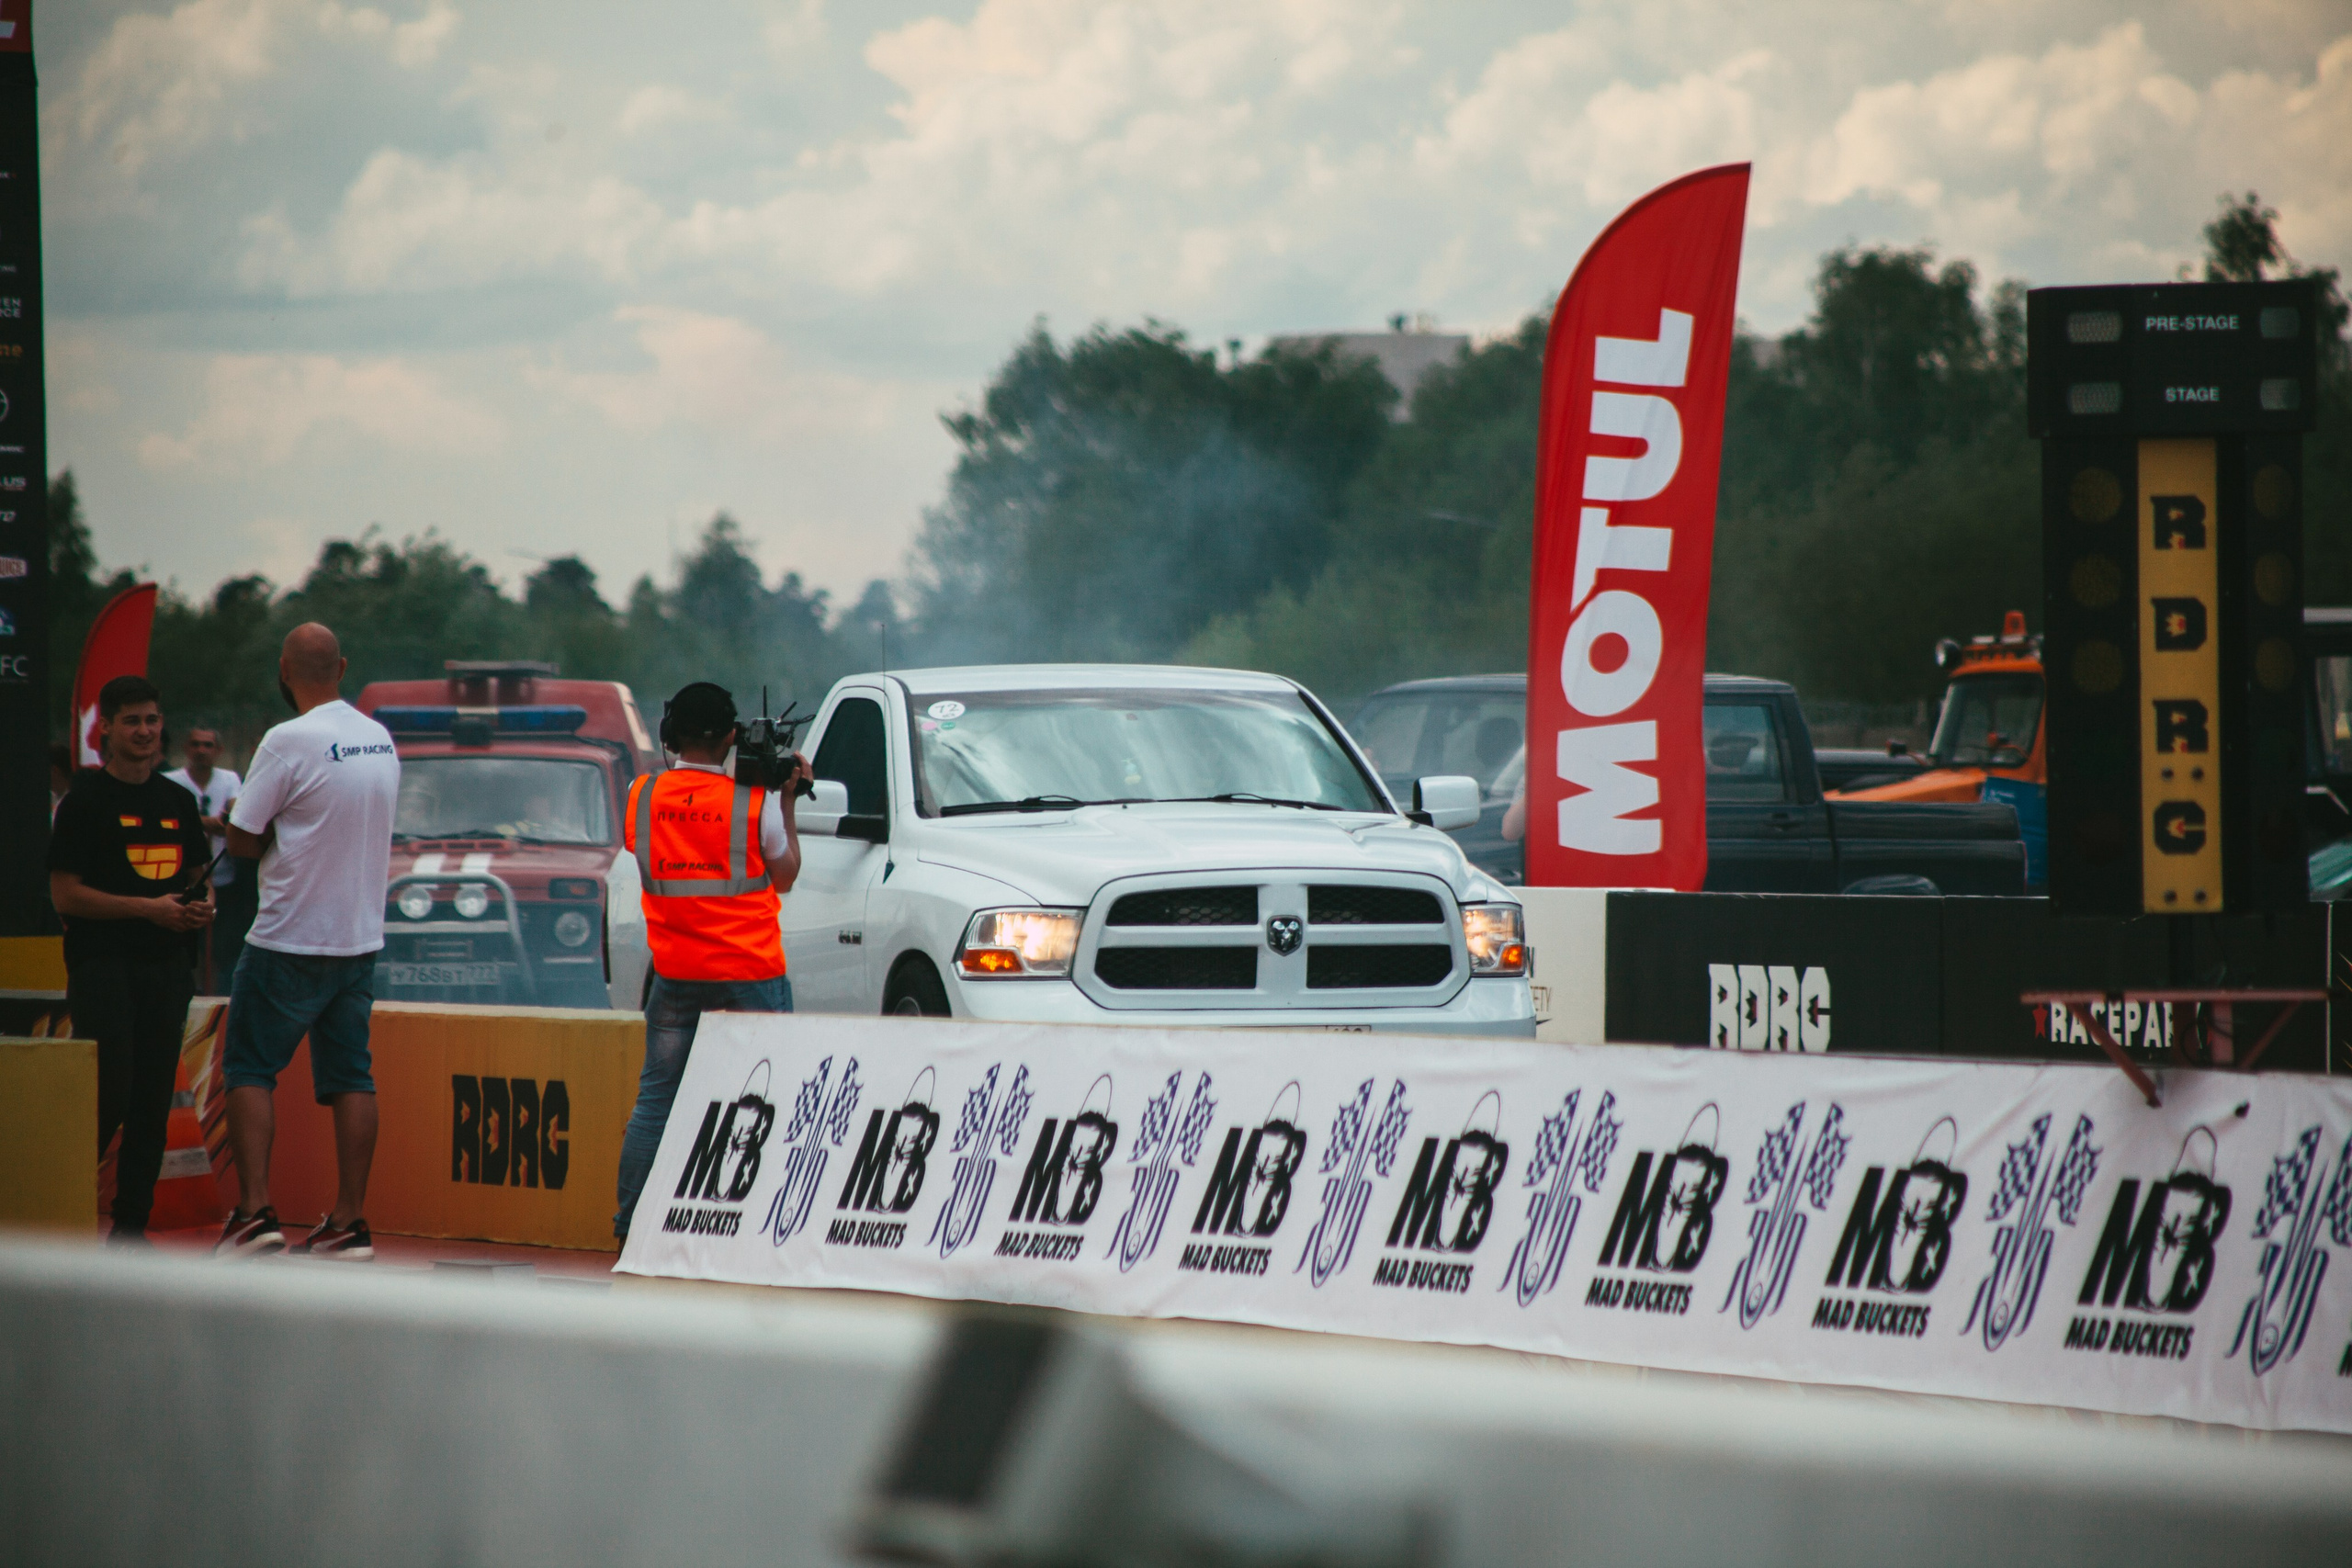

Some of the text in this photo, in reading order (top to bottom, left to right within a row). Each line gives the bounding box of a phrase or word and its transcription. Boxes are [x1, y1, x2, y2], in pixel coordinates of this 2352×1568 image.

[2145, 314, 2239, 331] PRE-STAGE
[2165, 387, 2220, 401] STAGE
[1555, 307, 1694, 856] MOTUL
[341, 744, 393, 758] SMP RACING
[657, 811, 723, 823] ПРЕССА
[666, 863, 724, 872] SMP RACING
[1708, 964, 1831, 1053] RDRC
[451, 1074, 570, 1190] RDRC
[662, 1208, 742, 1236] MAD BUCKETS
[826, 1219, 907, 1248] MAD BUCKETS
[995, 1232, 1084, 1260] MAD BUCKETS
[1179, 1245, 1272, 1275] MAD BUCKETS
[1374, 1258, 1474, 1292] MAD BUCKETS
[1586, 1278, 1692, 1314] MAD BUCKETS
[1812, 1298, 1931, 1337] MAD BUCKETS
[2064, 1316, 2195, 1360] MAD BUCKETS
